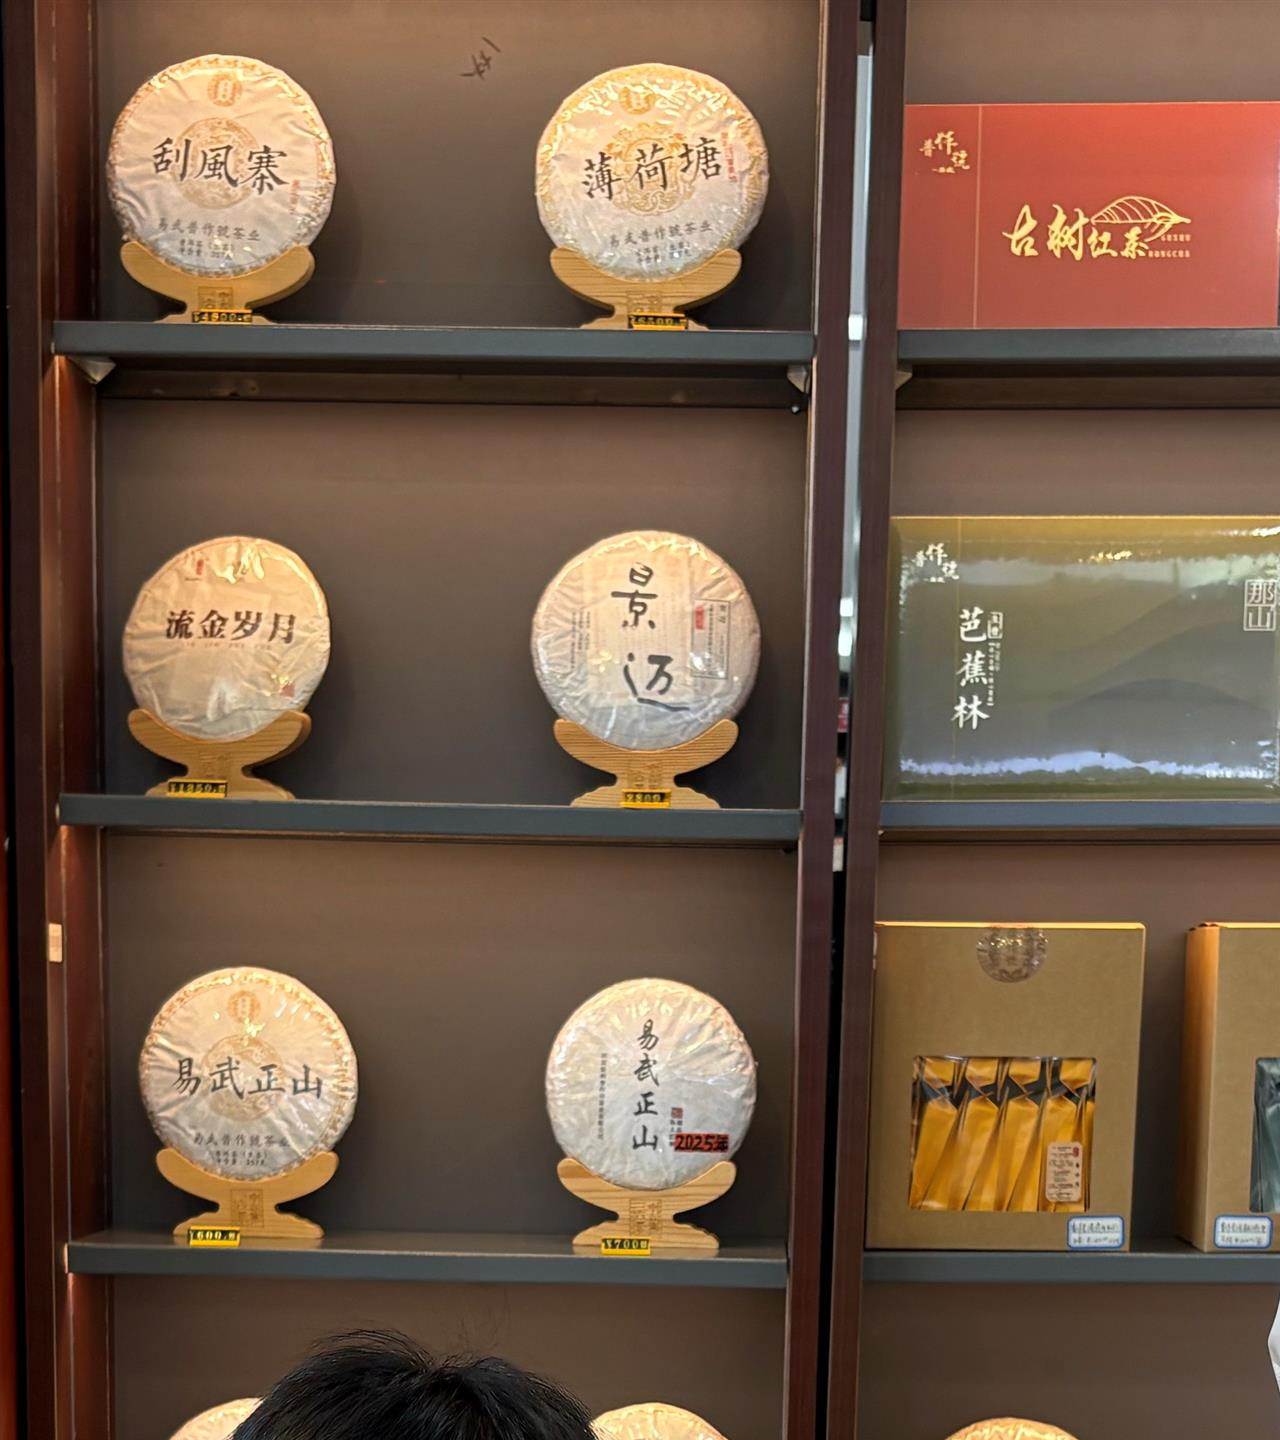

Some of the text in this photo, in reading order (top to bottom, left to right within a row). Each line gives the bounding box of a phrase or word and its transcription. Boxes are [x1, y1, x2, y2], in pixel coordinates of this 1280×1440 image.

[152, 137, 289, 195] 刮風寨
[581, 136, 722, 200] 薄荷塘
[166, 609, 297, 644] 流金岁月
[611, 562, 690, 711] 景迈
[951, 606, 990, 730] 芭蕉林
[171, 1056, 323, 1100] 易武正山
[632, 1018, 660, 1151] 易武正山
